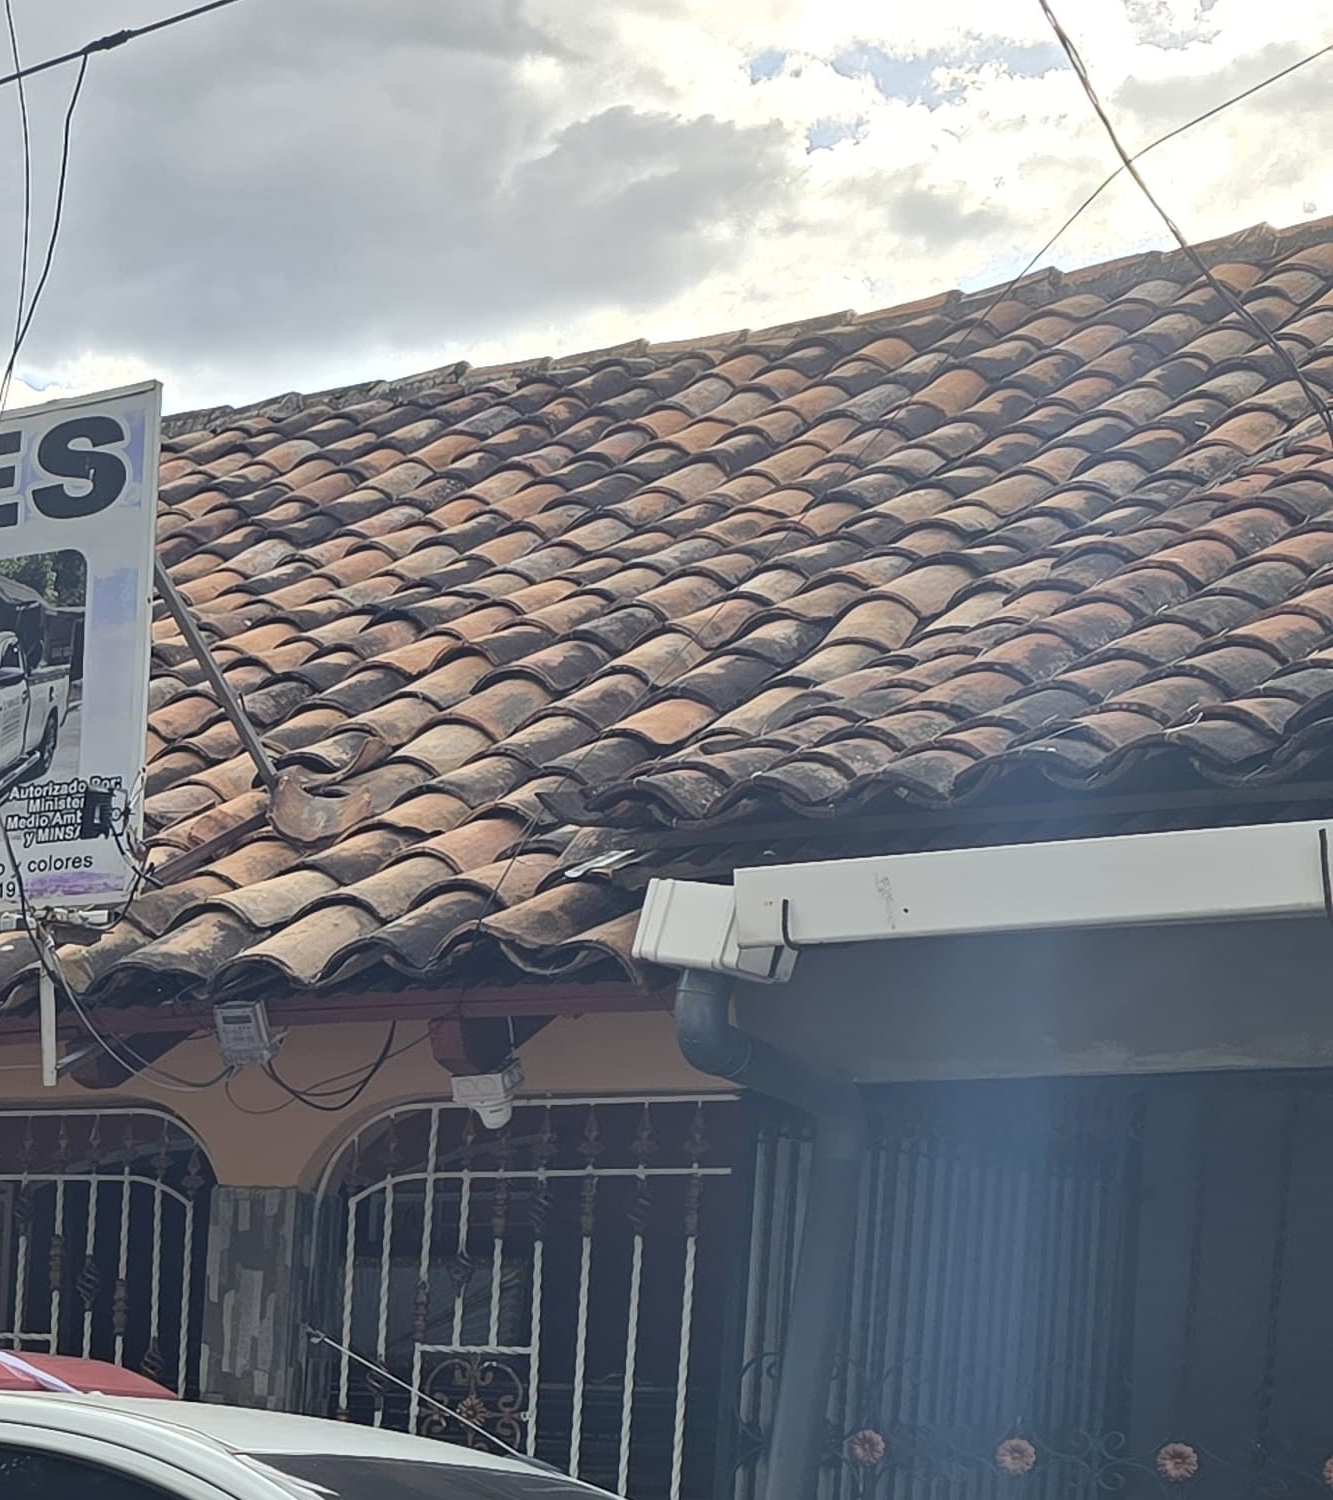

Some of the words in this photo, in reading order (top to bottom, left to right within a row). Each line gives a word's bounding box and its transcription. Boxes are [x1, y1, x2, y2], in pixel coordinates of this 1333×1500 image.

[8, 777, 87, 800] Autorizado
[6, 814, 49, 831] Medio
[24, 832, 34, 848] y
[27, 854, 94, 874] colores
